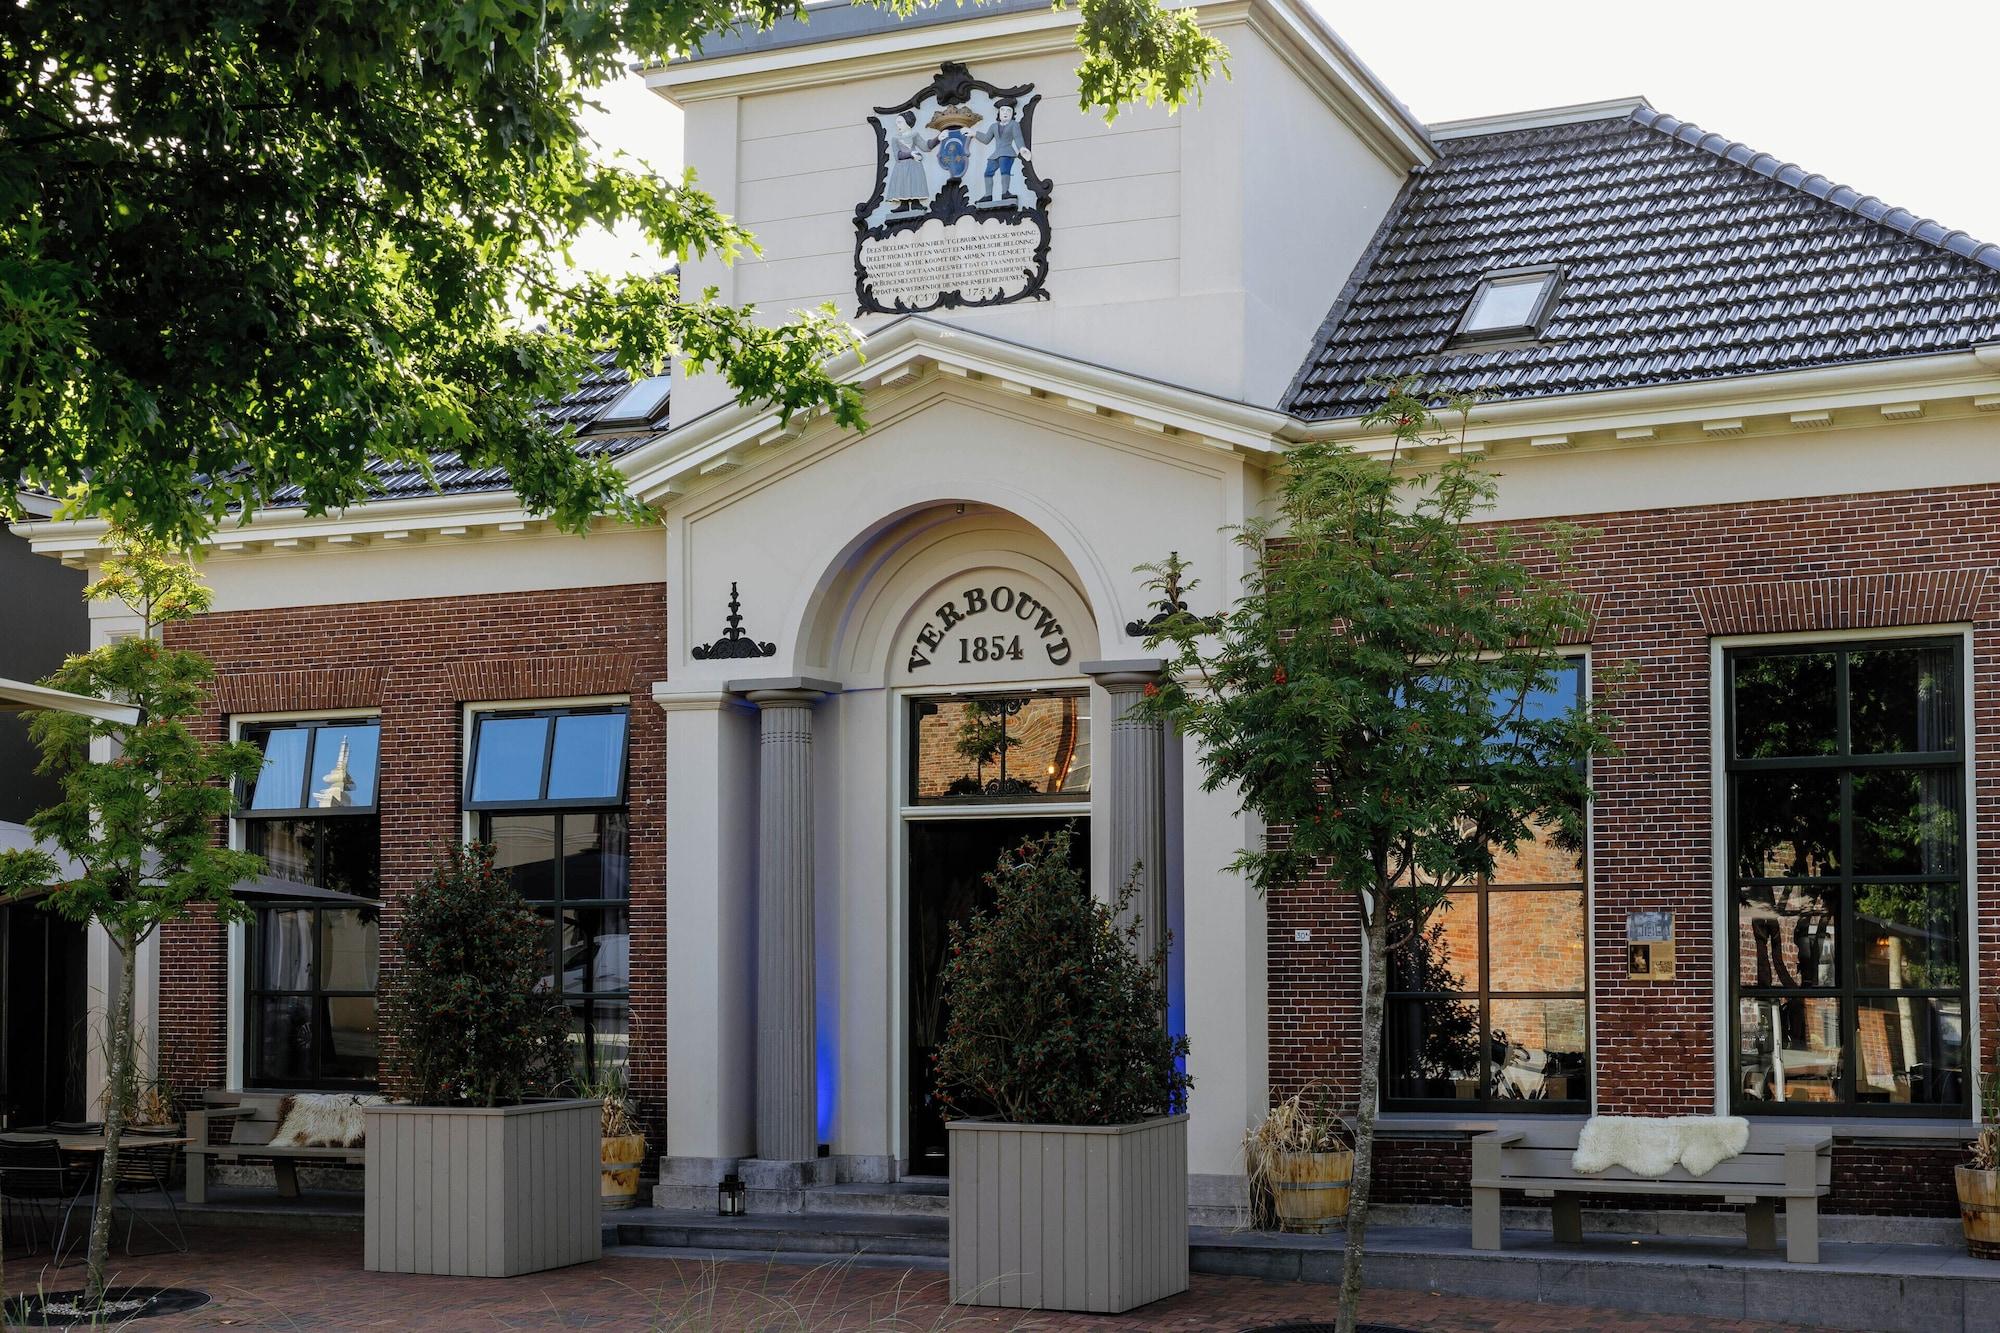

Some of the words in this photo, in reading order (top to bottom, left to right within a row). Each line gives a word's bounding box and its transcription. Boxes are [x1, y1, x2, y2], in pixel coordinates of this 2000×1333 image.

[966, 287, 993, 296] 1758
[907, 586, 1072, 673] VERBOUWD
[958, 635, 1024, 664] 1854
